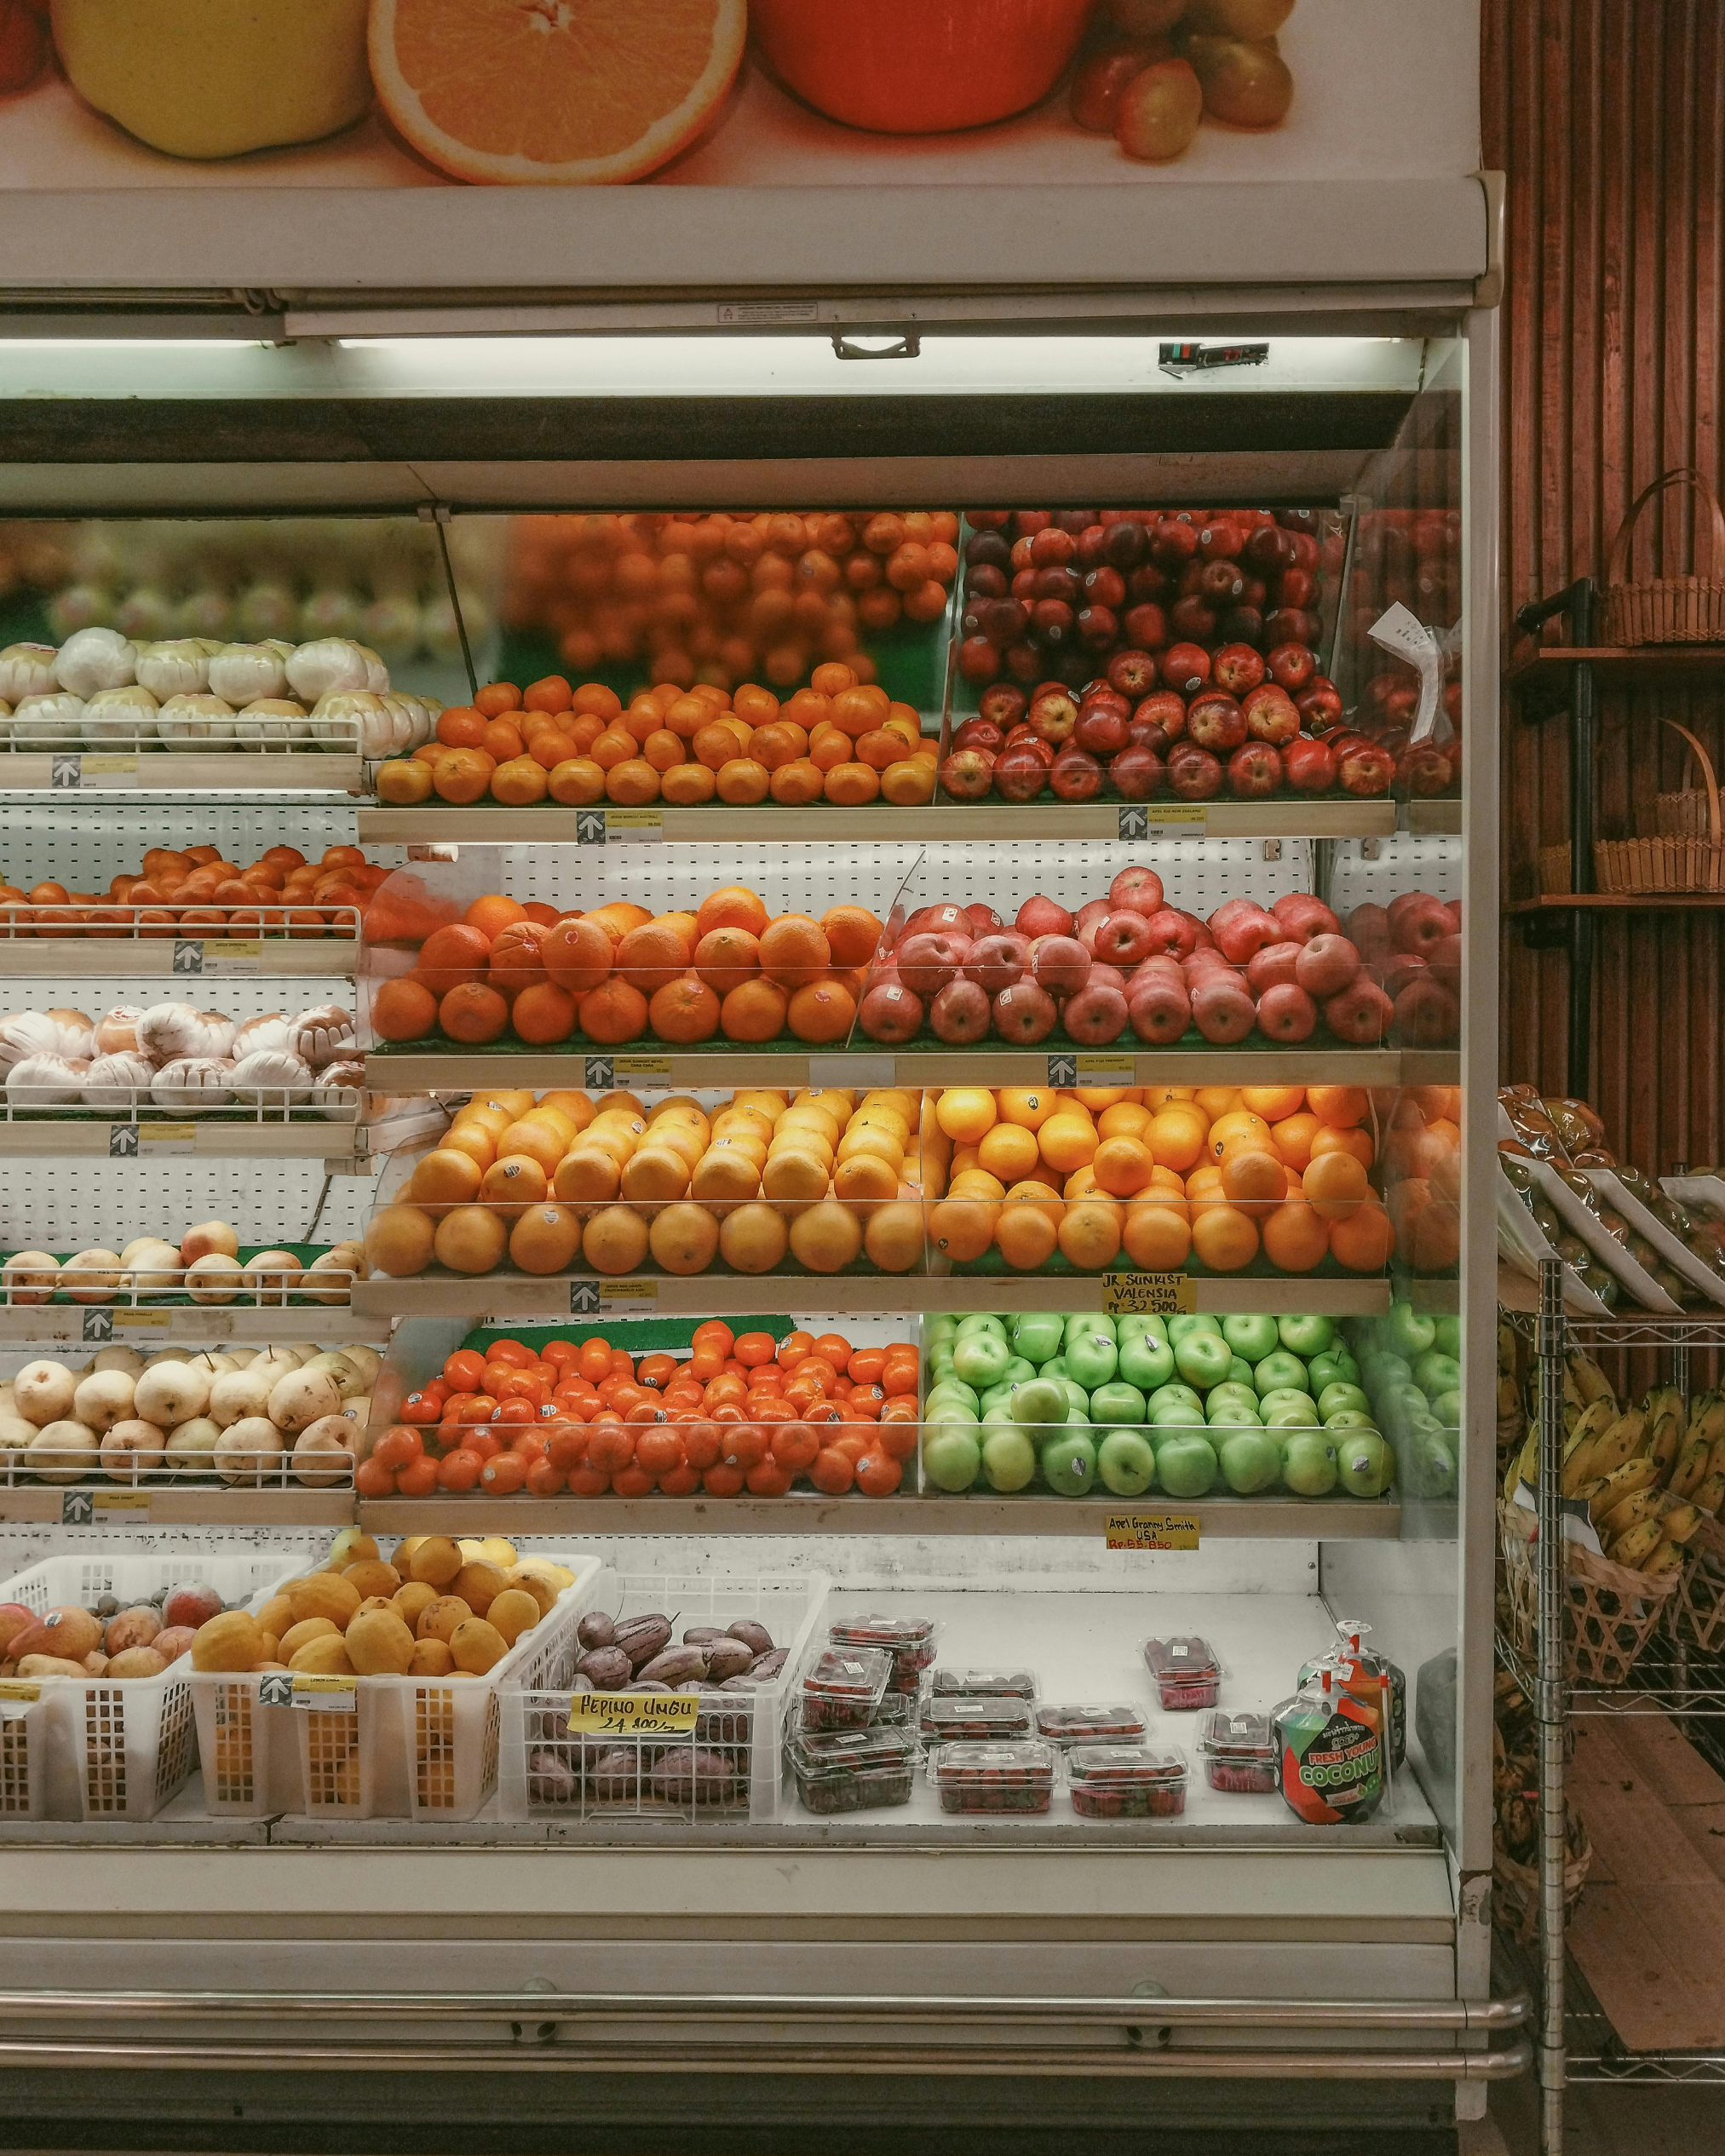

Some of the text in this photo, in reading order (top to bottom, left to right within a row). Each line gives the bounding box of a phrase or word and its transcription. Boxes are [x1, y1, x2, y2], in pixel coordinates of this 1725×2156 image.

[1125, 1273, 1184, 1286] SUNKIST
[1113, 1287, 1177, 1300] VALENSIA
[1108, 1516, 1197, 1532] Apel Granny Smith
[1136, 1530, 1158, 1541] USA
[1308, 1736, 1377, 1766] FRESH YOUNG
[1299, 1744, 1379, 1787] COCONU
